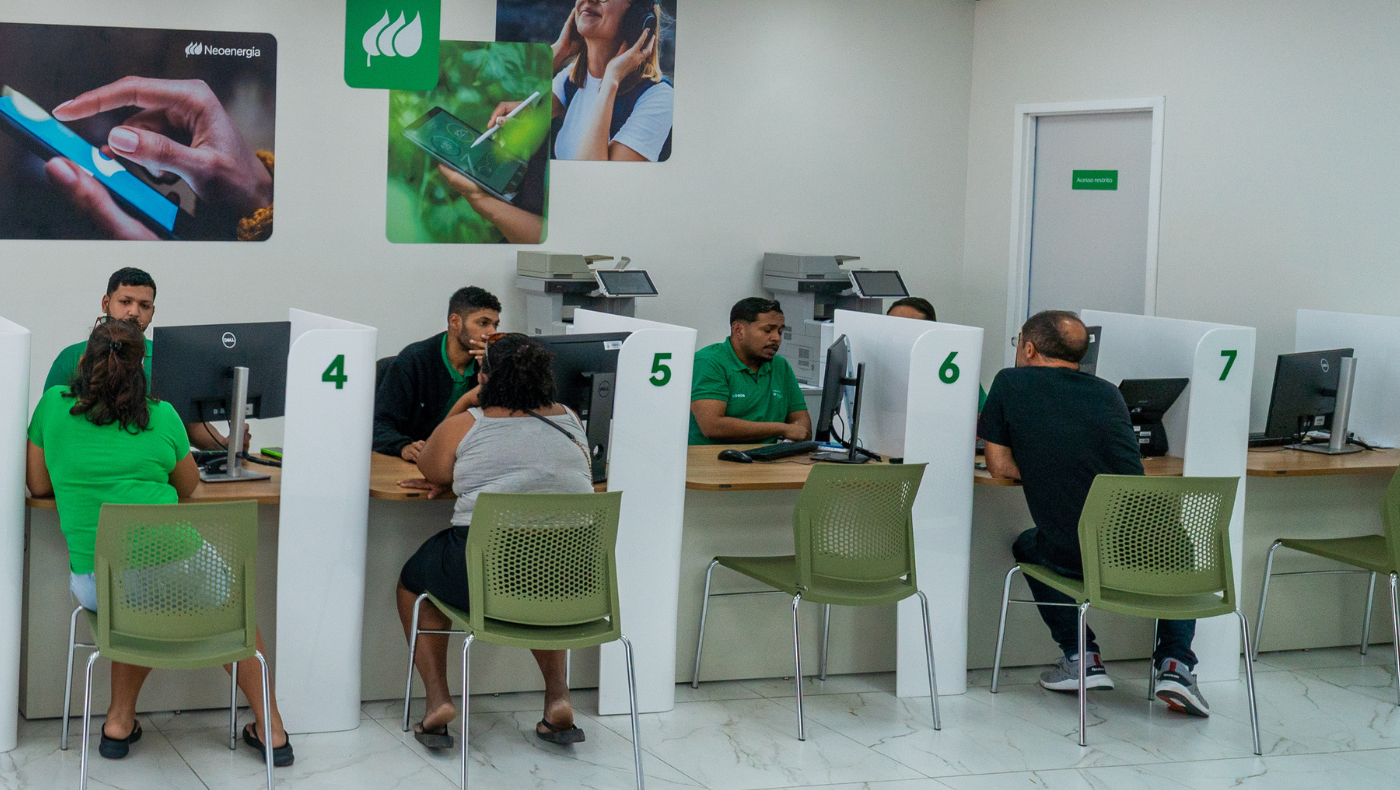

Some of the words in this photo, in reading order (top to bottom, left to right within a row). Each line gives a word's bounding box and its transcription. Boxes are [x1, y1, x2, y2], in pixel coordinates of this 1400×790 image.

[204, 44, 262, 59] Neoenergia
[321, 354, 348, 390] 4
[649, 352, 672, 387] 5
[938, 351, 960, 385] 6
[1218, 349, 1238, 381] 7
